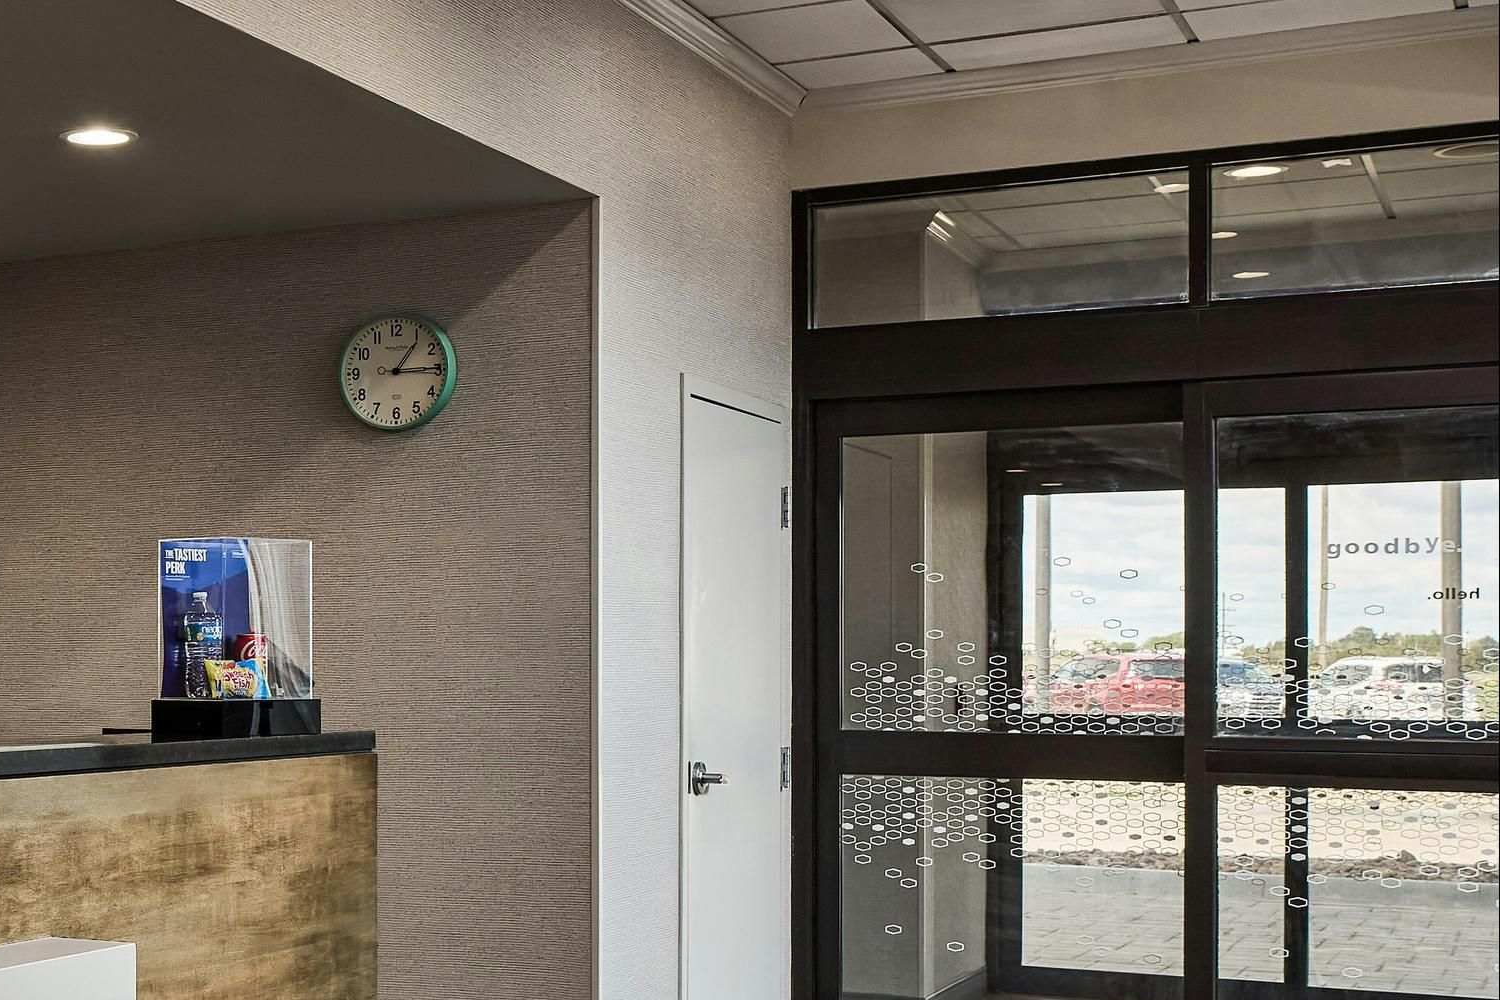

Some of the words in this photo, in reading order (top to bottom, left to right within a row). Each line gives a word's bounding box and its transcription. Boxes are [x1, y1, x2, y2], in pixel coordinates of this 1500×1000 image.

[390, 324, 403, 337] 12
[373, 331, 381, 345] 11
[358, 347, 370, 361] 10
[427, 342, 436, 356] 2
[351, 367, 360, 381] 9
[433, 363, 443, 377] 3
[357, 388, 366, 401] 8
[427, 385, 436, 398] 4
[372, 402, 381, 415] 7
[392, 406, 401, 420] 6
[412, 401, 421, 414] 5
[165, 549, 175, 559] THE
[174, 548, 208, 562] TASTIEST
[165, 561, 186, 574] PERK
